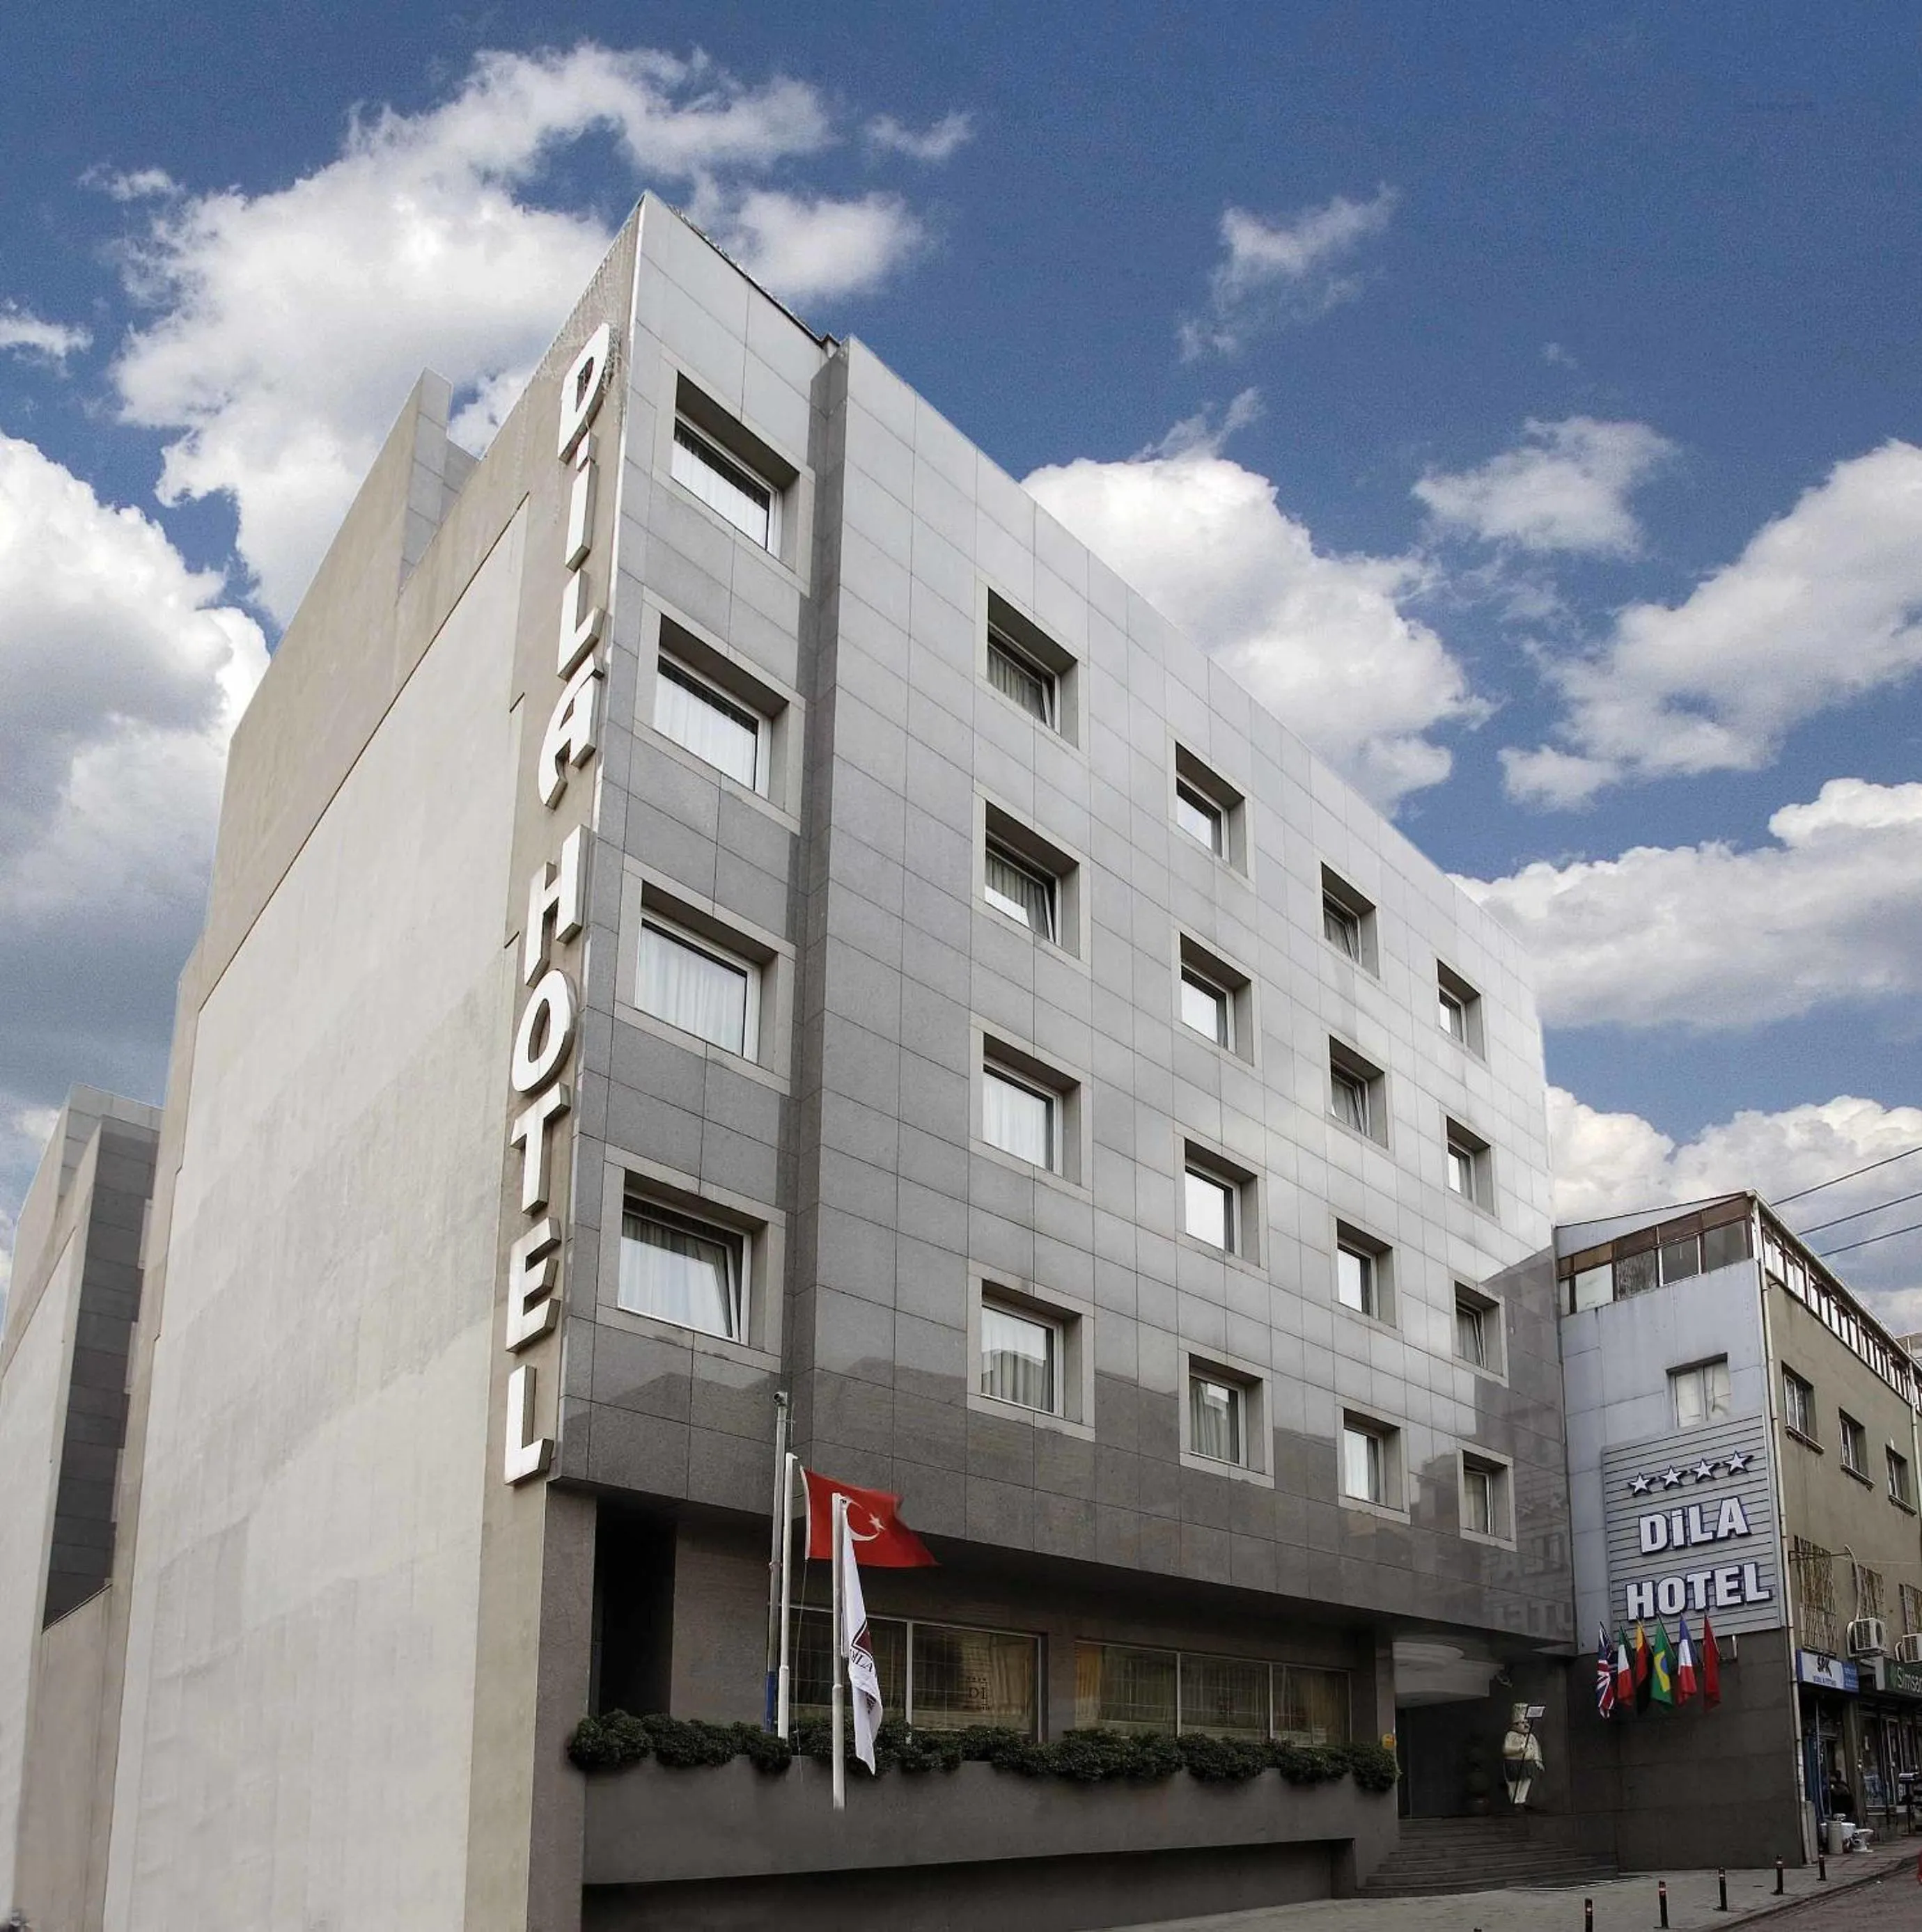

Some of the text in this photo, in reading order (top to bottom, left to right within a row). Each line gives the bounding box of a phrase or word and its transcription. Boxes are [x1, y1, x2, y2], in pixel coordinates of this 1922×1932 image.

[505, 824, 584, 1486] HOTEL
[1626, 1562, 1770, 1621] HOTEL
[1897, 1667, 1922, 1693] Simsa
